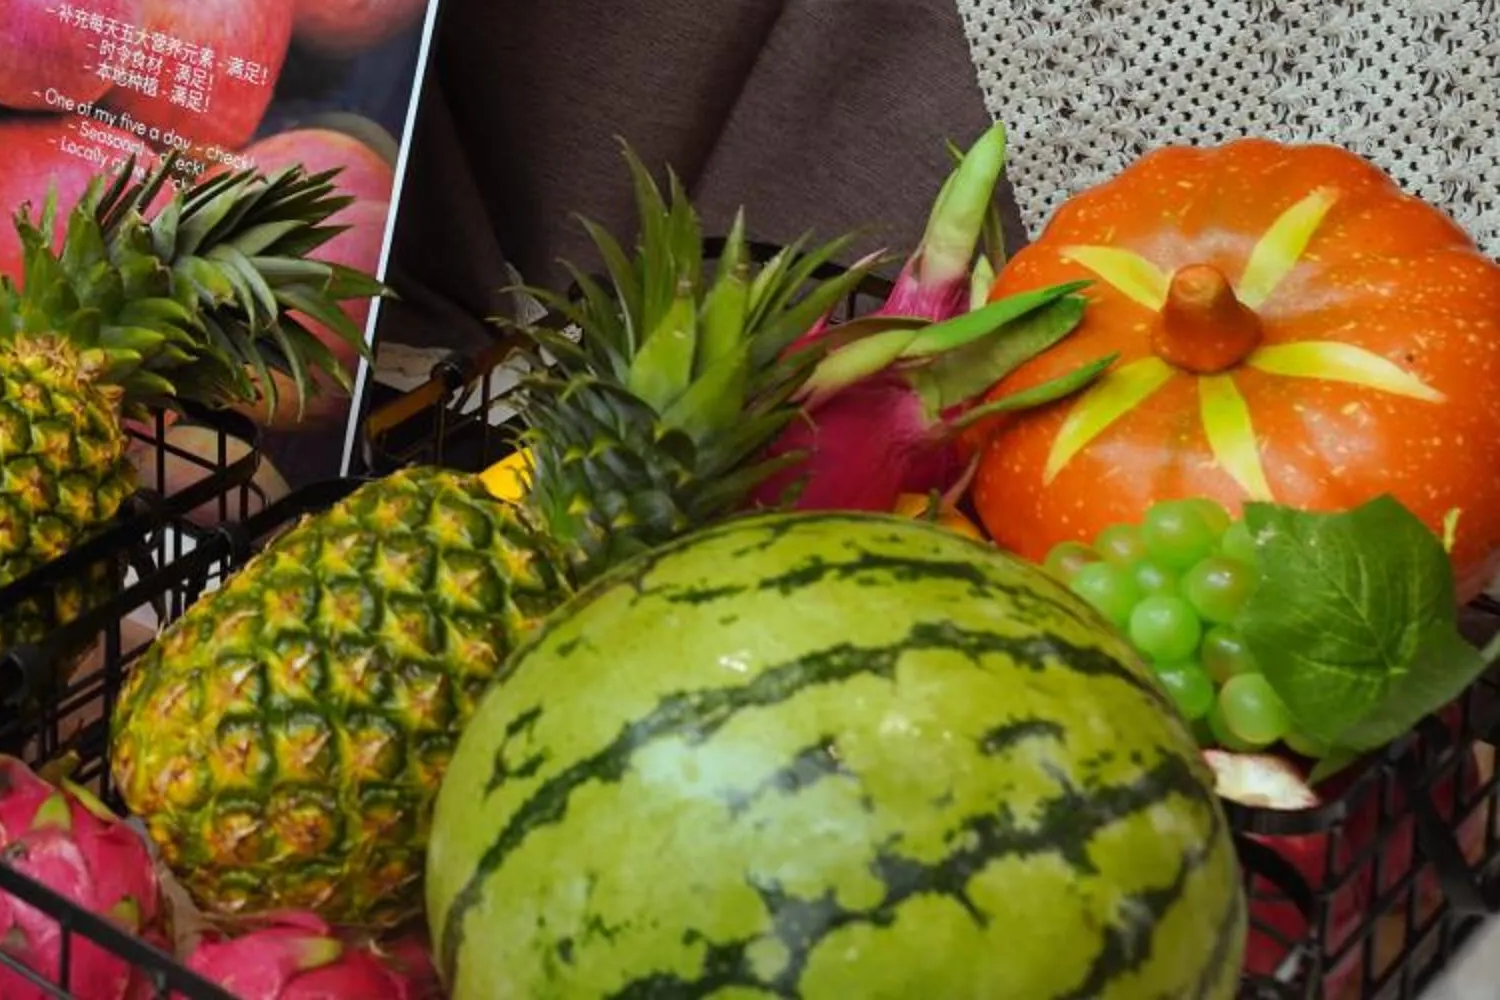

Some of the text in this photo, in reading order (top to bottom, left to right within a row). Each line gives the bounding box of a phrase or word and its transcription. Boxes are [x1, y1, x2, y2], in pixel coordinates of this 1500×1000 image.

[45, 87, 75, 111] One
[77, 101, 94, 117] of
[94, 108, 117, 129] my
[120, 111, 146, 136] five
[149, 127, 160, 140] a
[163, 128, 192, 155] day
[79, 120, 145, 157] Seasonal
[160, 152, 205, 176] ceck!
[60, 135, 109, 169] Locally
